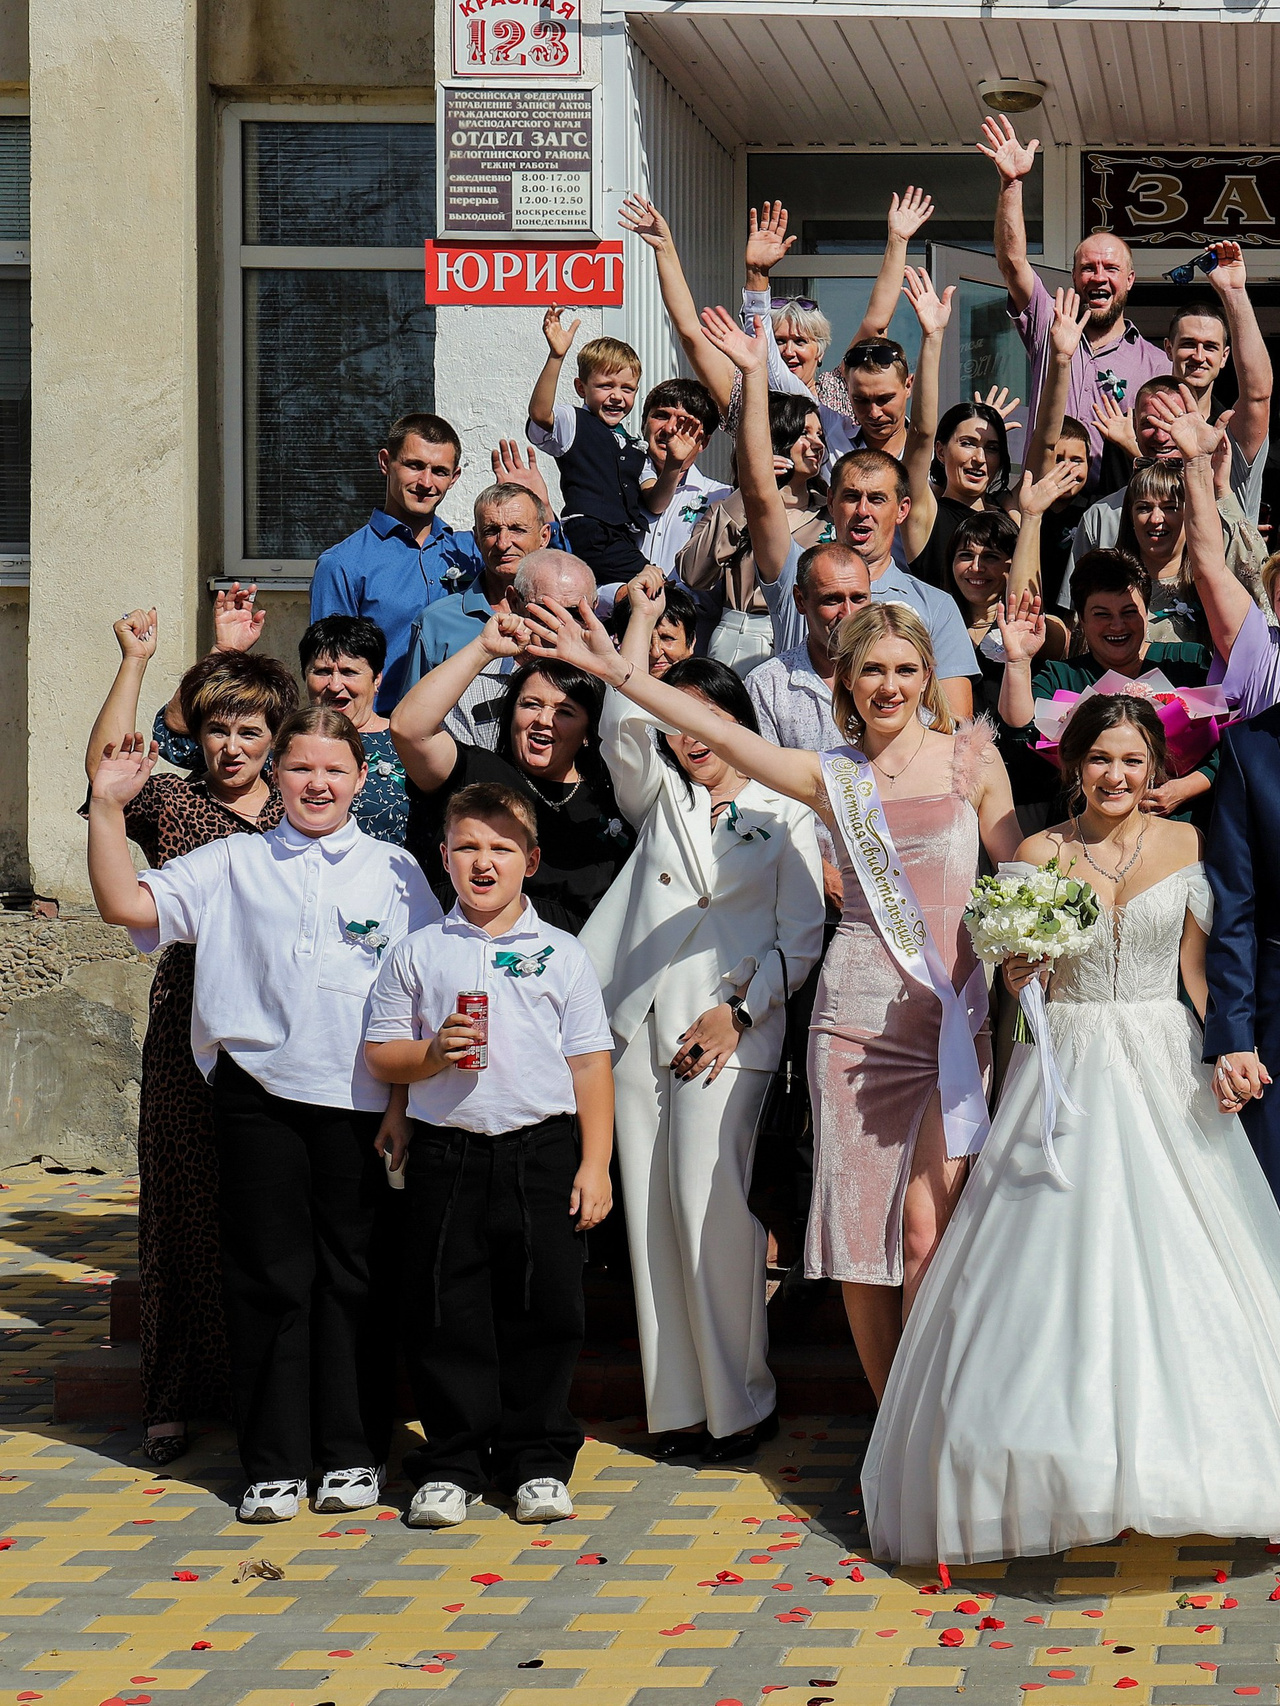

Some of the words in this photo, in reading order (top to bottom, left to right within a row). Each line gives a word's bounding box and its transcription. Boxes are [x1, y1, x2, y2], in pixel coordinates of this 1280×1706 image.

[466, 19, 569, 66] 123
[454, 92, 520, 100] РОССИЙСКАЯ
[524, 92, 584, 101] ФЕДЕРАЦИЯ
[448, 101, 512, 109] УПРАВЛЕНИЕ
[516, 102, 555, 110] ЗАПИСИ
[448, 111, 529, 120] ГРАЖДАНСКОГО
[532, 111, 591, 119] СОСТОЯНИЯ
[458, 120, 550, 128] КРАСНОДАРСКОГО
[554, 120, 581, 128] КРАЯ
[451, 131, 523, 149] ОТДЕЛ
[530, 131, 588, 147] ЗАГС
[449, 150, 541, 159] БЕЛОГЛИНСКОГО
[545, 150, 591, 159] РАЙОНА
[449, 174, 511, 183] ежедневно
[449, 185, 497, 194] пятница
[449, 197, 499, 206] перерыв
[449, 211, 506, 222] выходной
[515, 208, 587, 217] воскресенье
[515, 219, 588, 227] понедельник
[436, 252, 623, 292] ЮРИСТ
[859, 808, 919, 957] свидетельница
